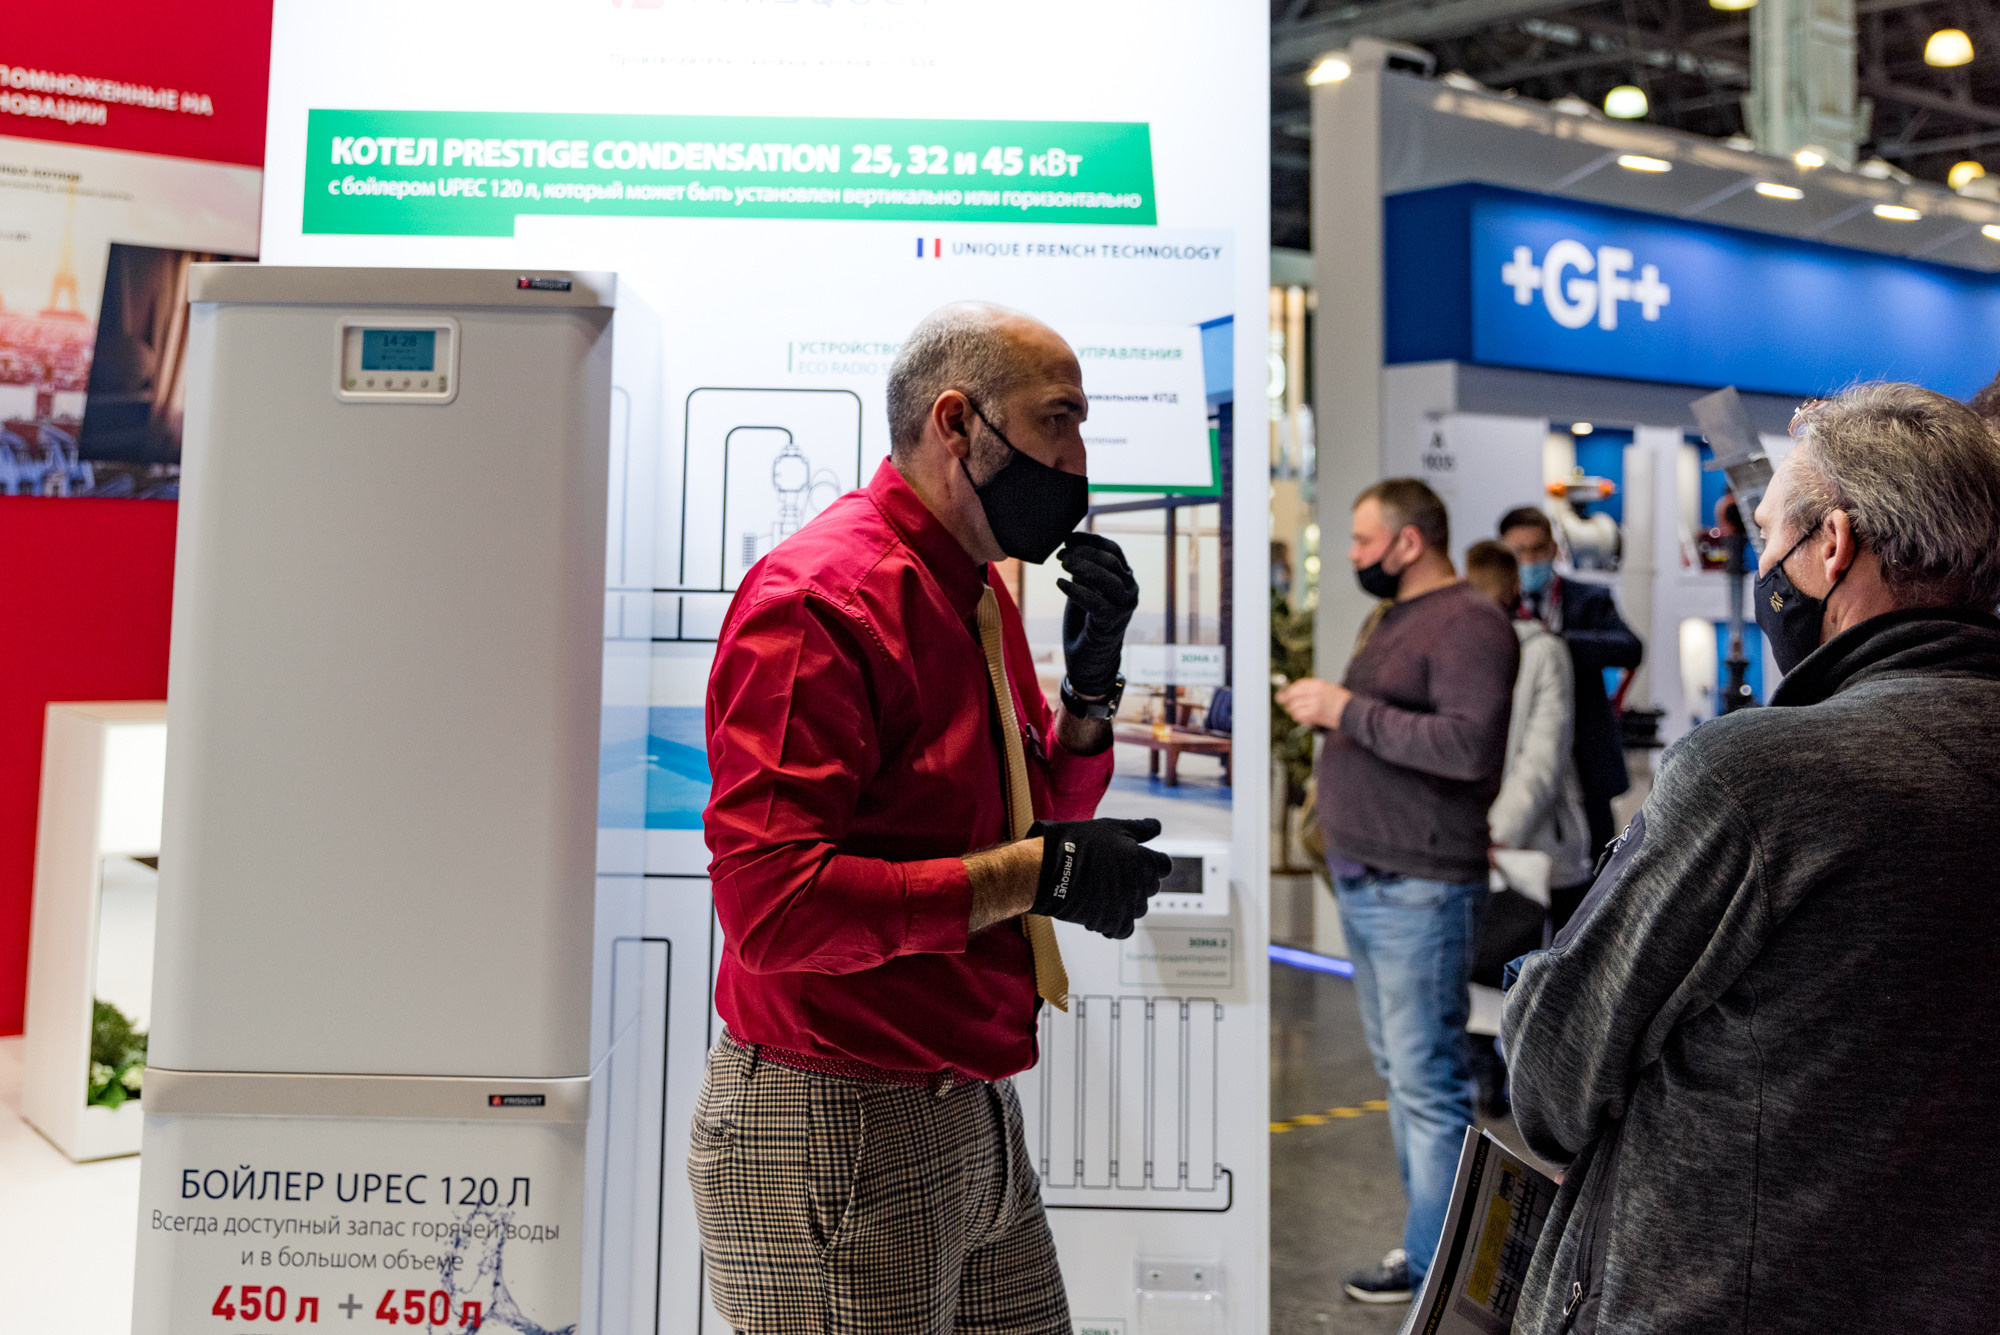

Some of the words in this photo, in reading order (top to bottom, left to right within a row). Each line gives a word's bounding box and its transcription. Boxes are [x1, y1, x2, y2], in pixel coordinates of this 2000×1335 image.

[180, 91, 214, 116] НА
[331, 136, 438, 166] КОТЕЛ
[443, 138, 589, 168] PRESTIGE
[592, 141, 840, 173] CONDENSATION
[850, 144, 901, 177] 25,
[907, 145, 948, 176] 32
[953, 151, 977, 175] и
[981, 146, 1023, 176] 45
[1029, 148, 1082, 177] кВт
[328, 180, 341, 195] с
[341, 175, 436, 200] бойлером
[438, 177, 487, 197] UPEC
[491, 178, 524, 198] 120
[543, 181, 624, 203] который
[625, 184, 686, 200] может
[686, 181, 734, 201] быть
[734, 186, 841, 206] установлен
[842, 188, 963, 208] вертикально
[964, 190, 1001, 206] или
[1002, 190, 1142, 211] горизонтально
[952, 242, 1020, 258] UNIQUE
[1026, 242, 1096, 258] FRENCH
[1101, 243, 1222, 260] TECHNOLOGY
[799, 362, 828, 375] ECO
[832, 362, 878, 376] RADIO
[1078, 347, 1182, 361] УПРАВЛЕНИЯ
[1057, 854, 1073, 900] FRISQUET
[180, 1165, 324, 1200] БОЙЛЕР
[336, 1173, 428, 1205] UPEC
[440, 1177, 498, 1206] 120
[507, 1177, 531, 1207] Л
[152, 1209, 218, 1235] Всегда
[223, 1214, 340, 1240] доступный
[347, 1219, 406, 1238] запас
[412, 1219, 499, 1244] горячей
[507, 1222, 560, 1243] воды
[241, 1249, 254, 1266] и
[261, 1251, 272, 1267] в
[278, 1246, 377, 1269] большом
[383, 1250, 465, 1272] объеме
[211, 1285, 286, 1322] 450
[295, 1298, 320, 1324] л
[375, 1288, 451, 1326] 450
[458, 1300, 482, 1328] л
